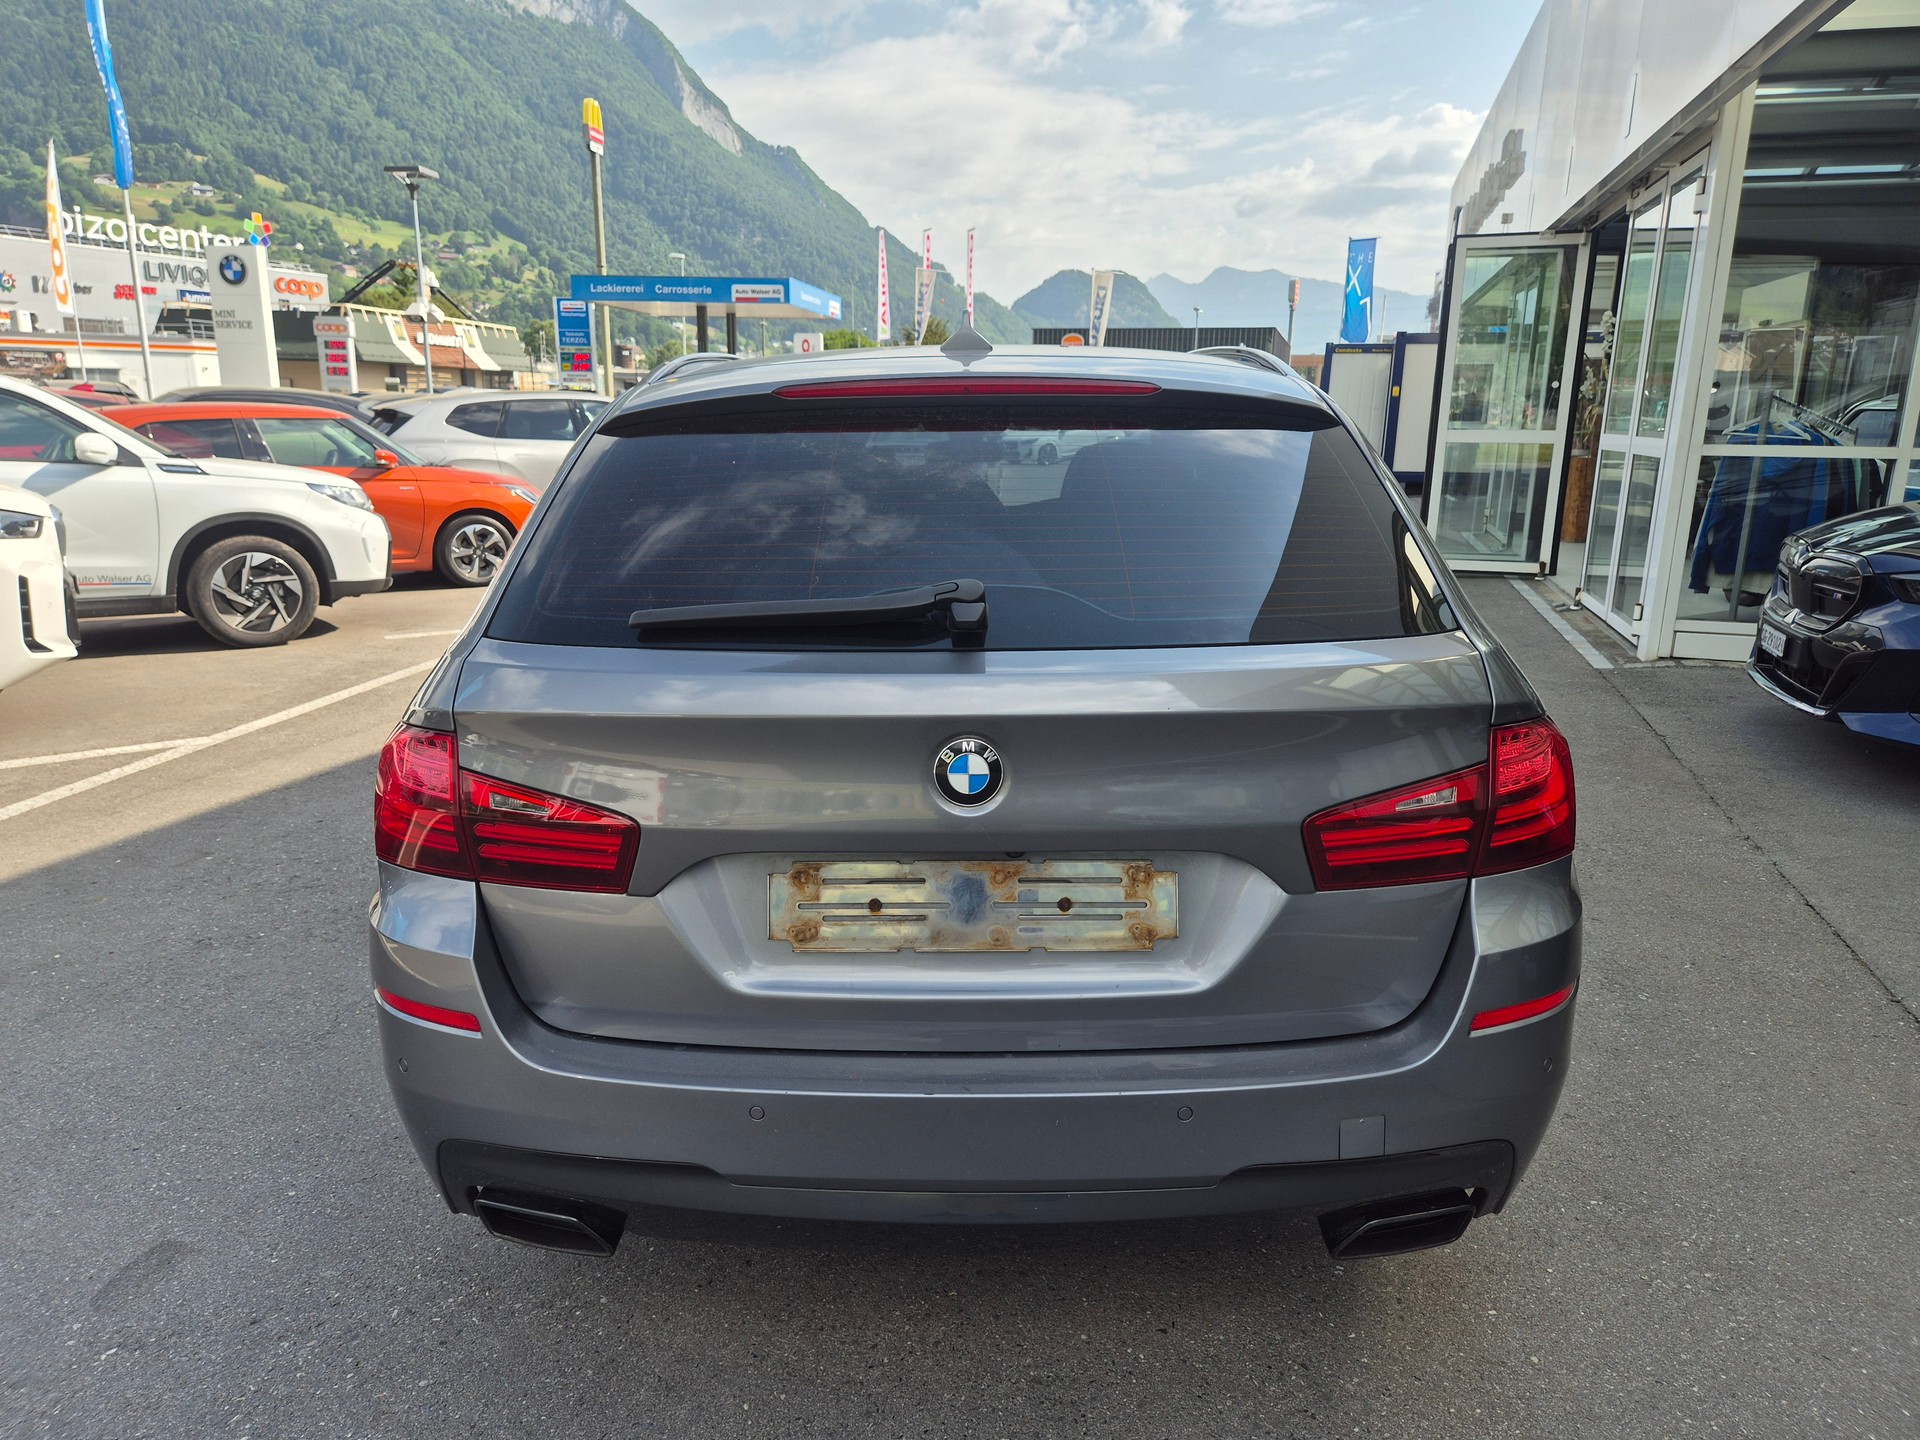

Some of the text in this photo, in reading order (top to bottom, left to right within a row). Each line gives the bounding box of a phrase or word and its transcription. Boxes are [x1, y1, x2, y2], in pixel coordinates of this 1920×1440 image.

[143, 260, 210, 289] LIVIQ
[274, 277, 324, 300] coop
[590, 283, 713, 295] Lackiererei Carrosserie
[214, 310, 236, 319] MINI
[216, 320, 254, 330] SERVICE
[315, 323, 349, 335] coop
[78, 575, 152, 583] uto Walser AG
[940, 741, 998, 764] BMW
